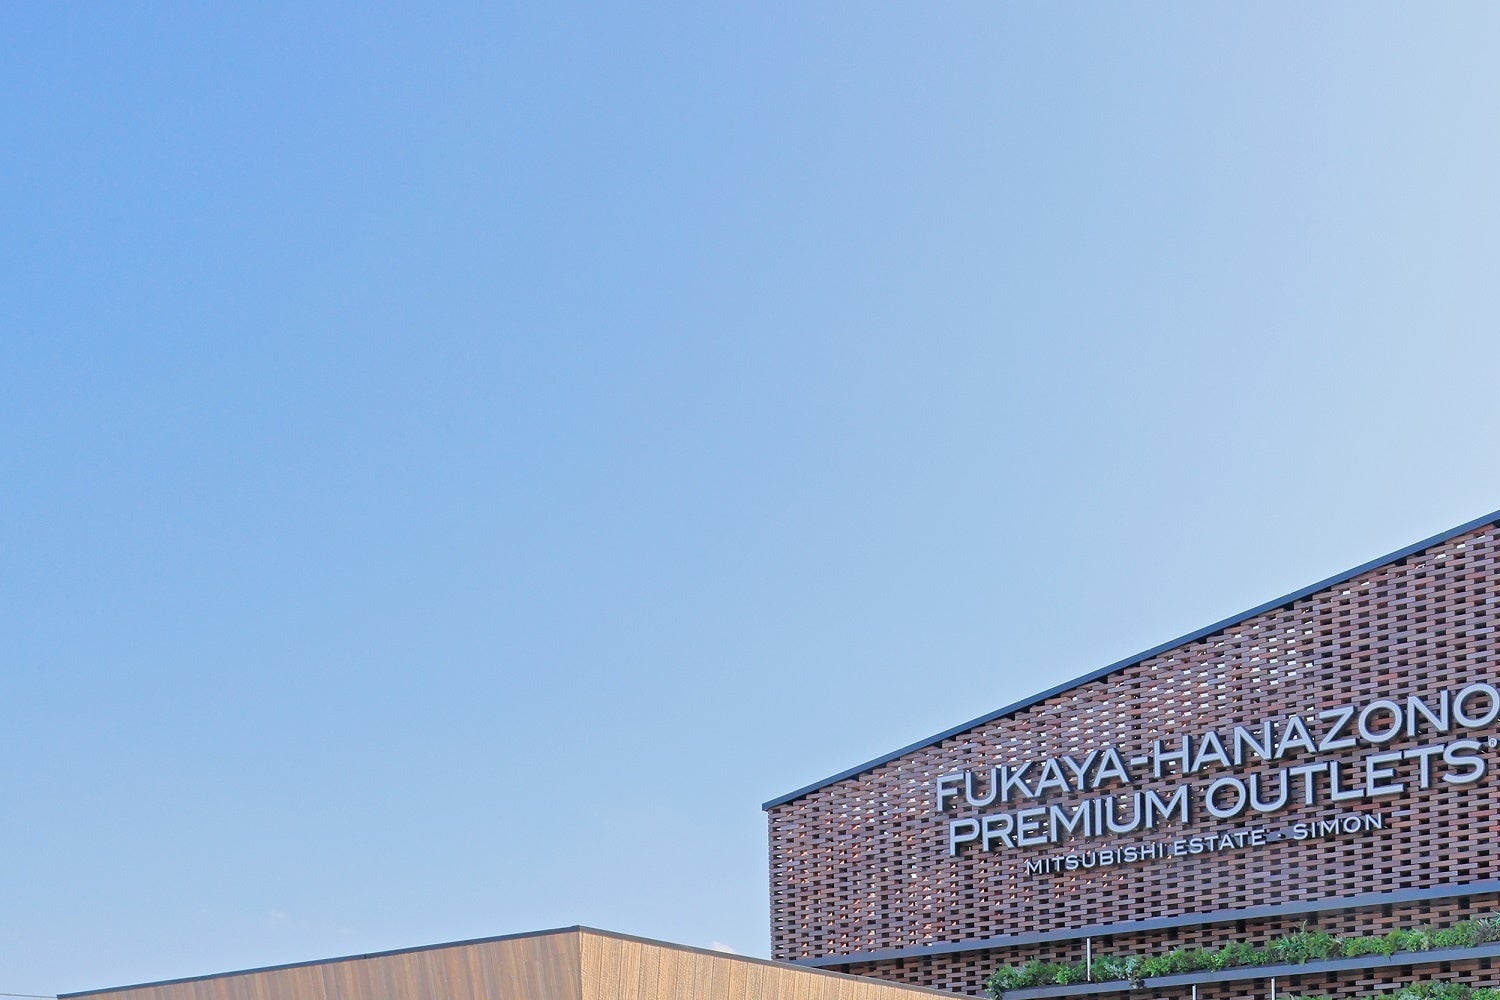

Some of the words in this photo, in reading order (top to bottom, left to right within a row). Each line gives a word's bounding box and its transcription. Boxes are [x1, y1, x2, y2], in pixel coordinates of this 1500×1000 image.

[949, 784, 1190, 857] PREMIUM
[1026, 842, 1166, 876] MITSUBISHI
[1174, 829, 1267, 856] ESTATE
[1292, 813, 1384, 841] SIMON
